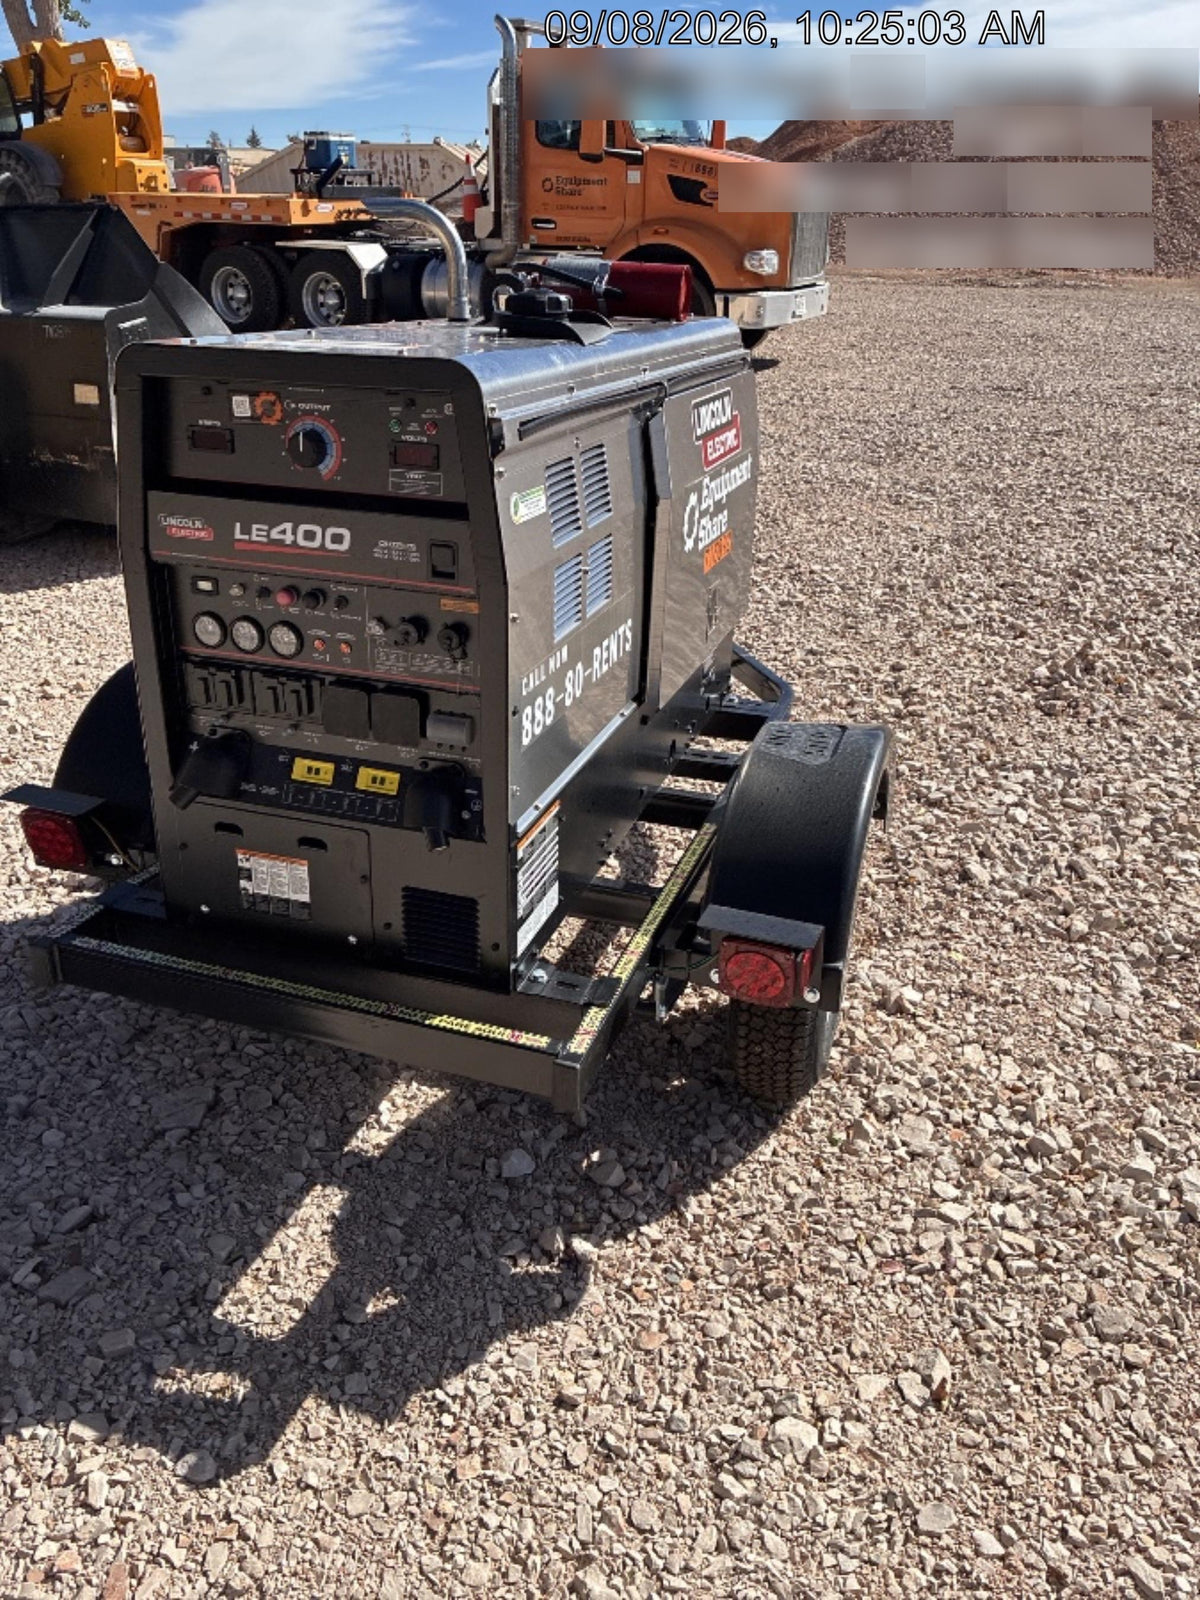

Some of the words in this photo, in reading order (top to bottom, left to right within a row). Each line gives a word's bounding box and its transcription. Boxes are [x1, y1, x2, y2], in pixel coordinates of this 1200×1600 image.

[555, 175, 608, 187] Equipment
[695, 396, 732, 436] LINCOLN
[700, 453, 752, 512] Equipment
[234, 522, 351, 552] LE400
[699, 508, 728, 551] Share
[522, 664, 546, 696] CALL
[522, 618, 633, 746] 888-80-RENTS
